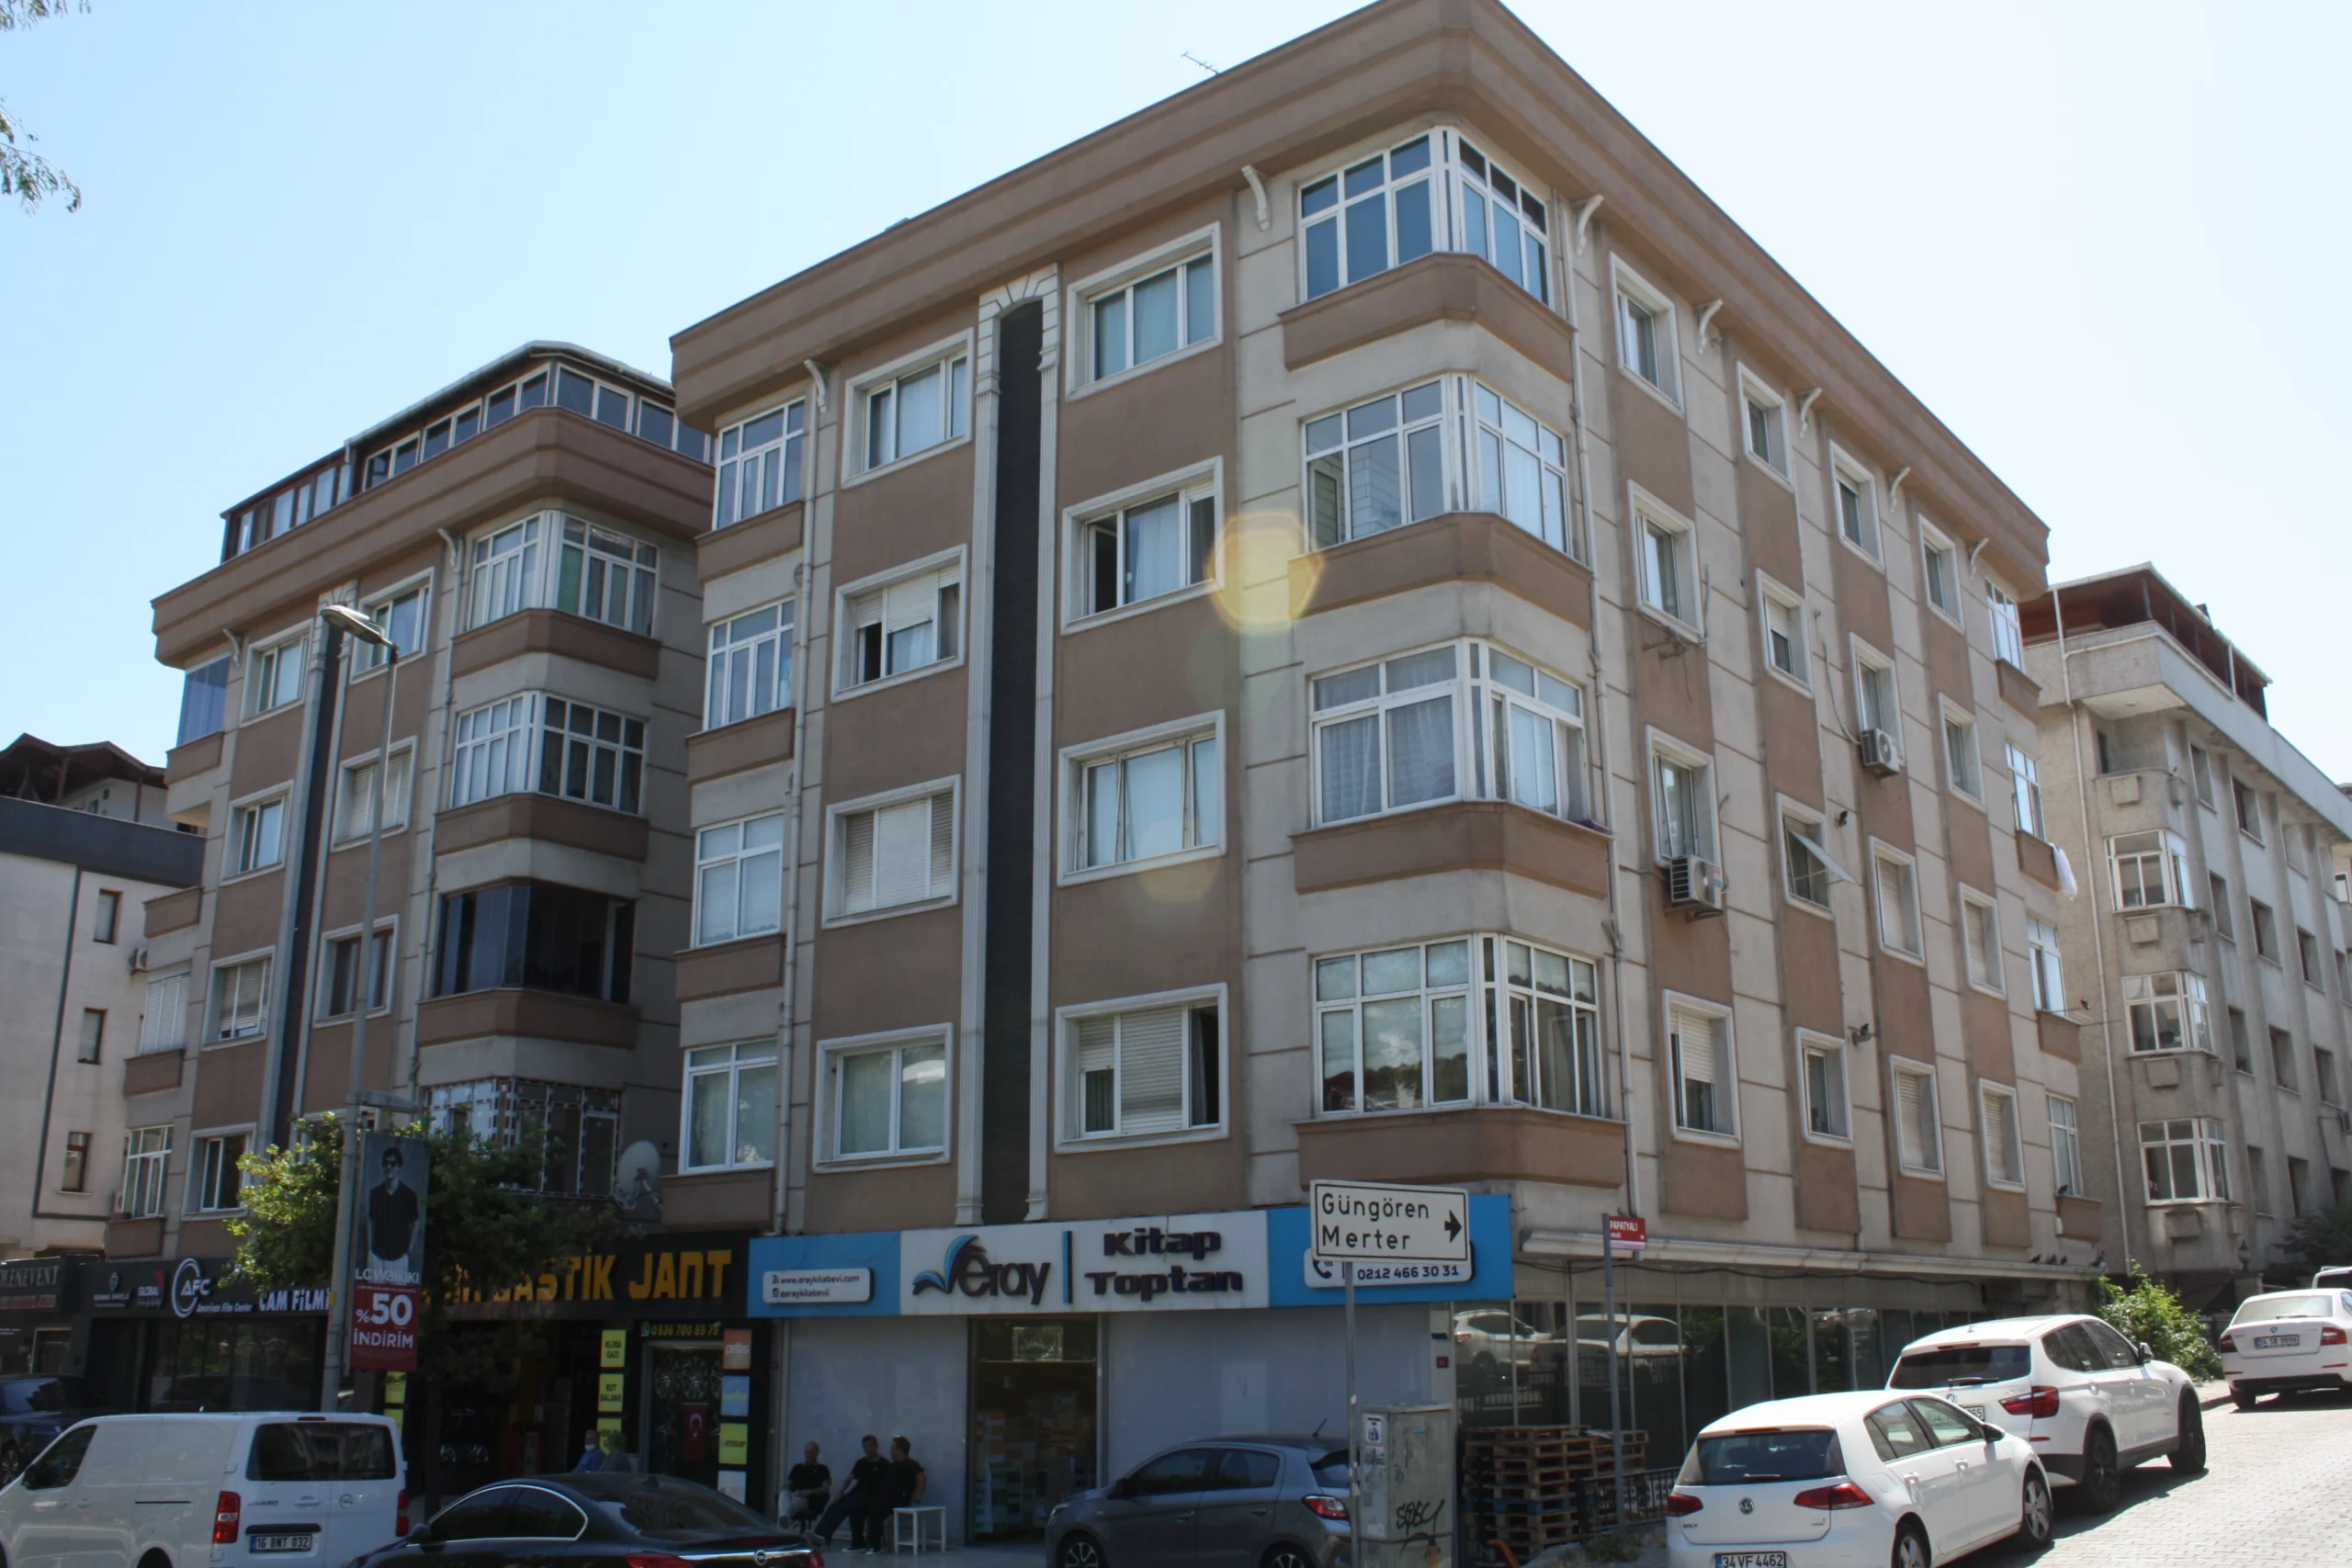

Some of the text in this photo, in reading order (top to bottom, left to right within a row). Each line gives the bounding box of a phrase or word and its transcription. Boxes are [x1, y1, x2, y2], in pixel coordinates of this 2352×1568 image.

[1321, 1192, 1430, 1223] Güngören
[1610, 1220, 1638, 1232] PAPATYALI
[1102, 1227, 1222, 1261] Kitap
[1321, 1224, 1411, 1250] Merter
[628, 1249, 733, 1301] JANT
[780, 1274, 860, 1286] www.eraykitabevi.com
[1358, 1265, 1459, 1280] 0212 466 30 31
[180, 1278, 211, 1296] AFC
[1084, 1265, 1243, 1303] Toptan
[353, 1327, 414, 1349] İNDİRİM
[651, 1324, 673, 1337] 0536
[675, 1324, 693, 1337] 700
[257, 1538, 266, 1549] 16
[291, 1536, 309, 1548] 032
[1722, 1554, 1784, 1568] 34 VF 4462
